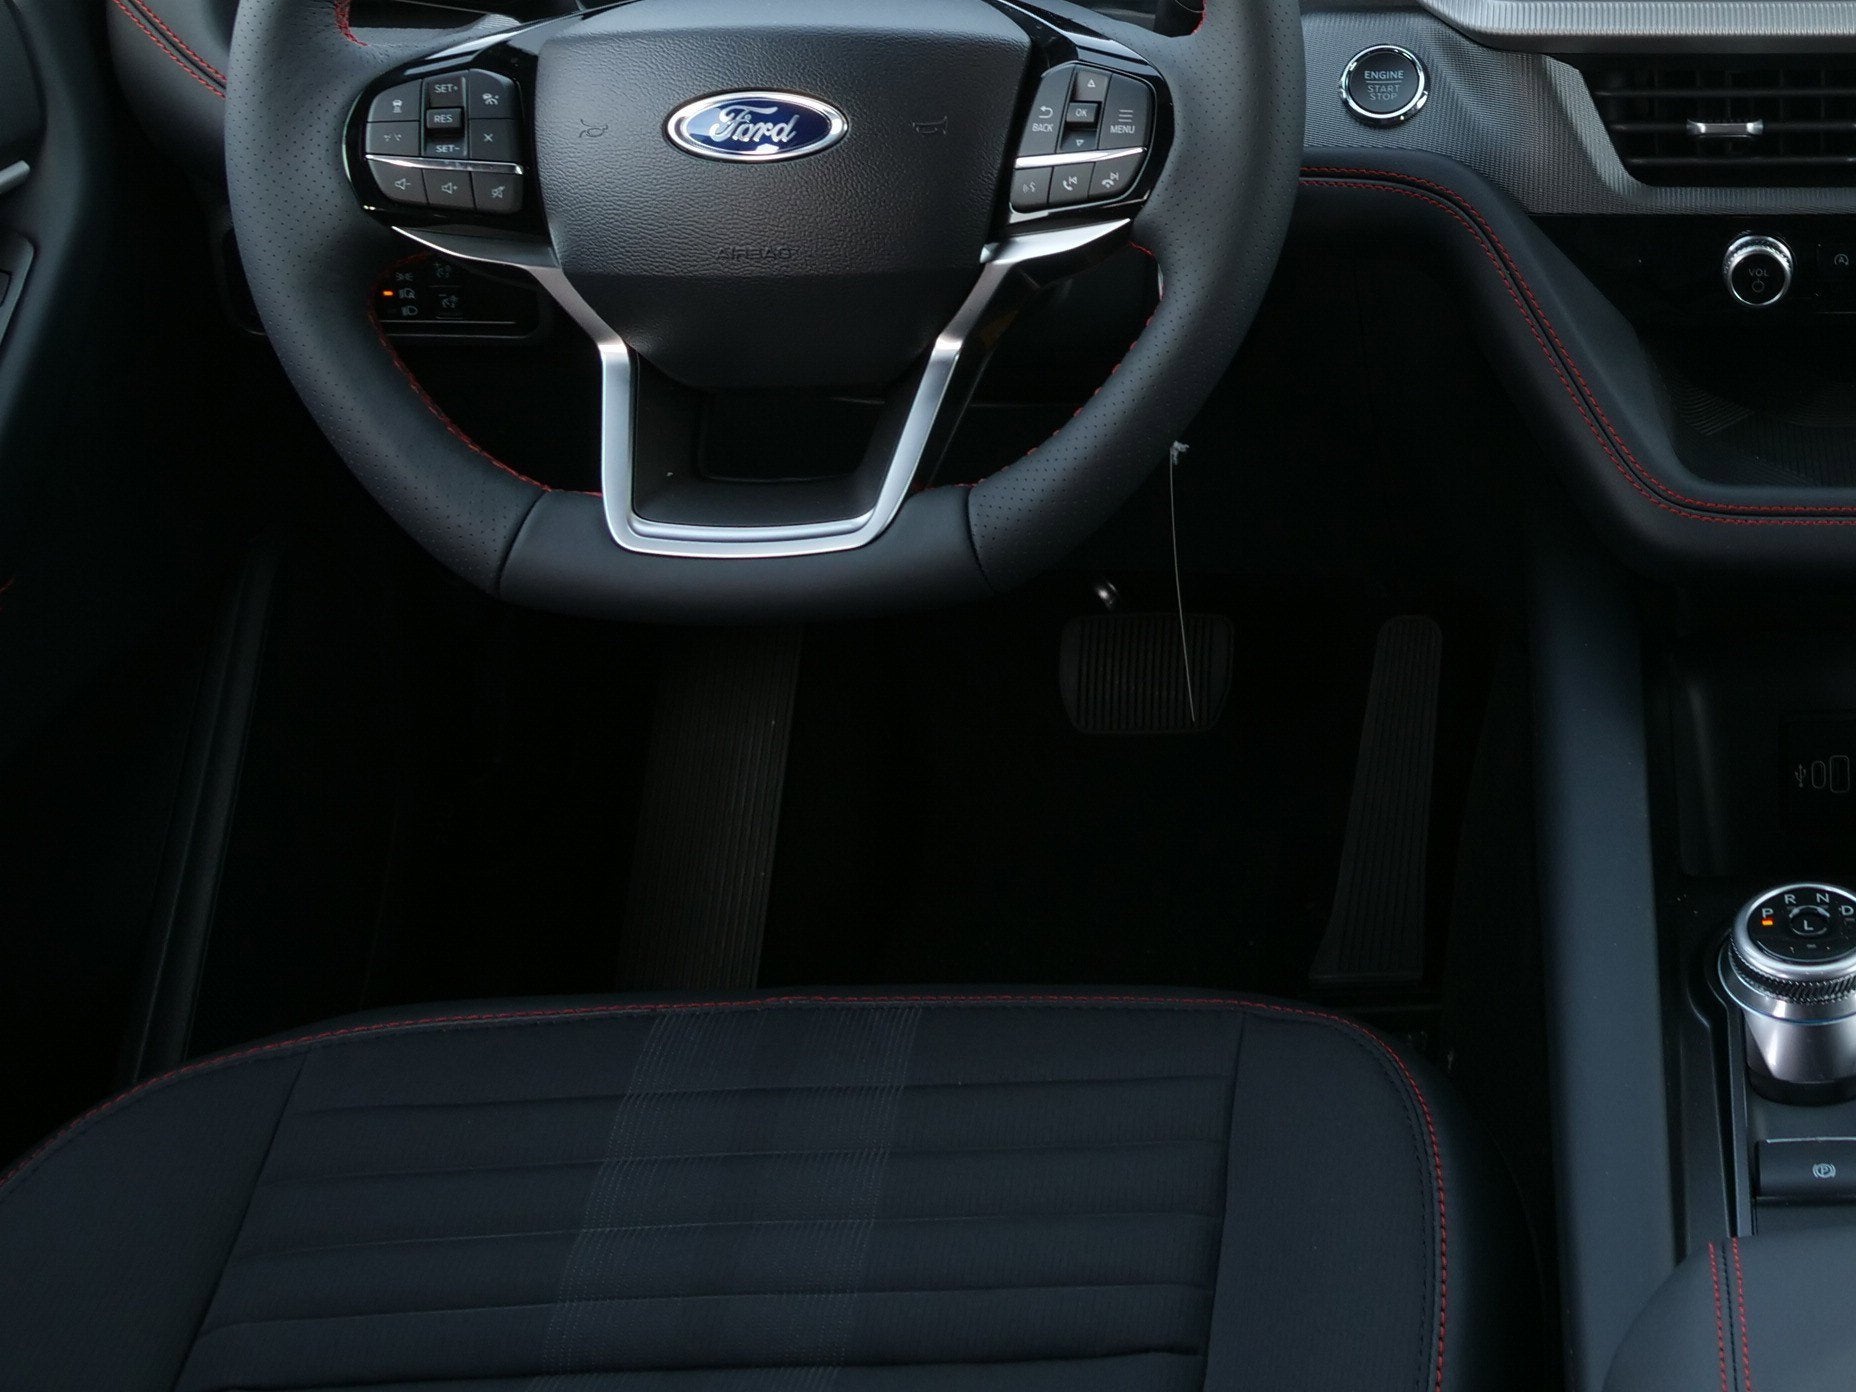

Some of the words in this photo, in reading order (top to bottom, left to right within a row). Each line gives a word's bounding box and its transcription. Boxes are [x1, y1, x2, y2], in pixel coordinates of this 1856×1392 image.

[1364, 70, 1405, 79] ENGINE
[1367, 84, 1400, 93] START
[1369, 92, 1398, 101] STOP
[1075, 109, 1088, 117] OK
[433, 114, 453, 124] RES
[708, 105, 800, 144] Ford
[1032, 123, 1054, 133] BACK
[1109, 125, 1136, 135] MENU
[1748, 269, 1769, 278] VOL
[1784, 893, 1796, 904] R
[1815, 892, 1829, 904] N
[1762, 908, 1774, 919] P
[1841, 905, 1854, 916] D
[1803, 920, 1814, 931] L
